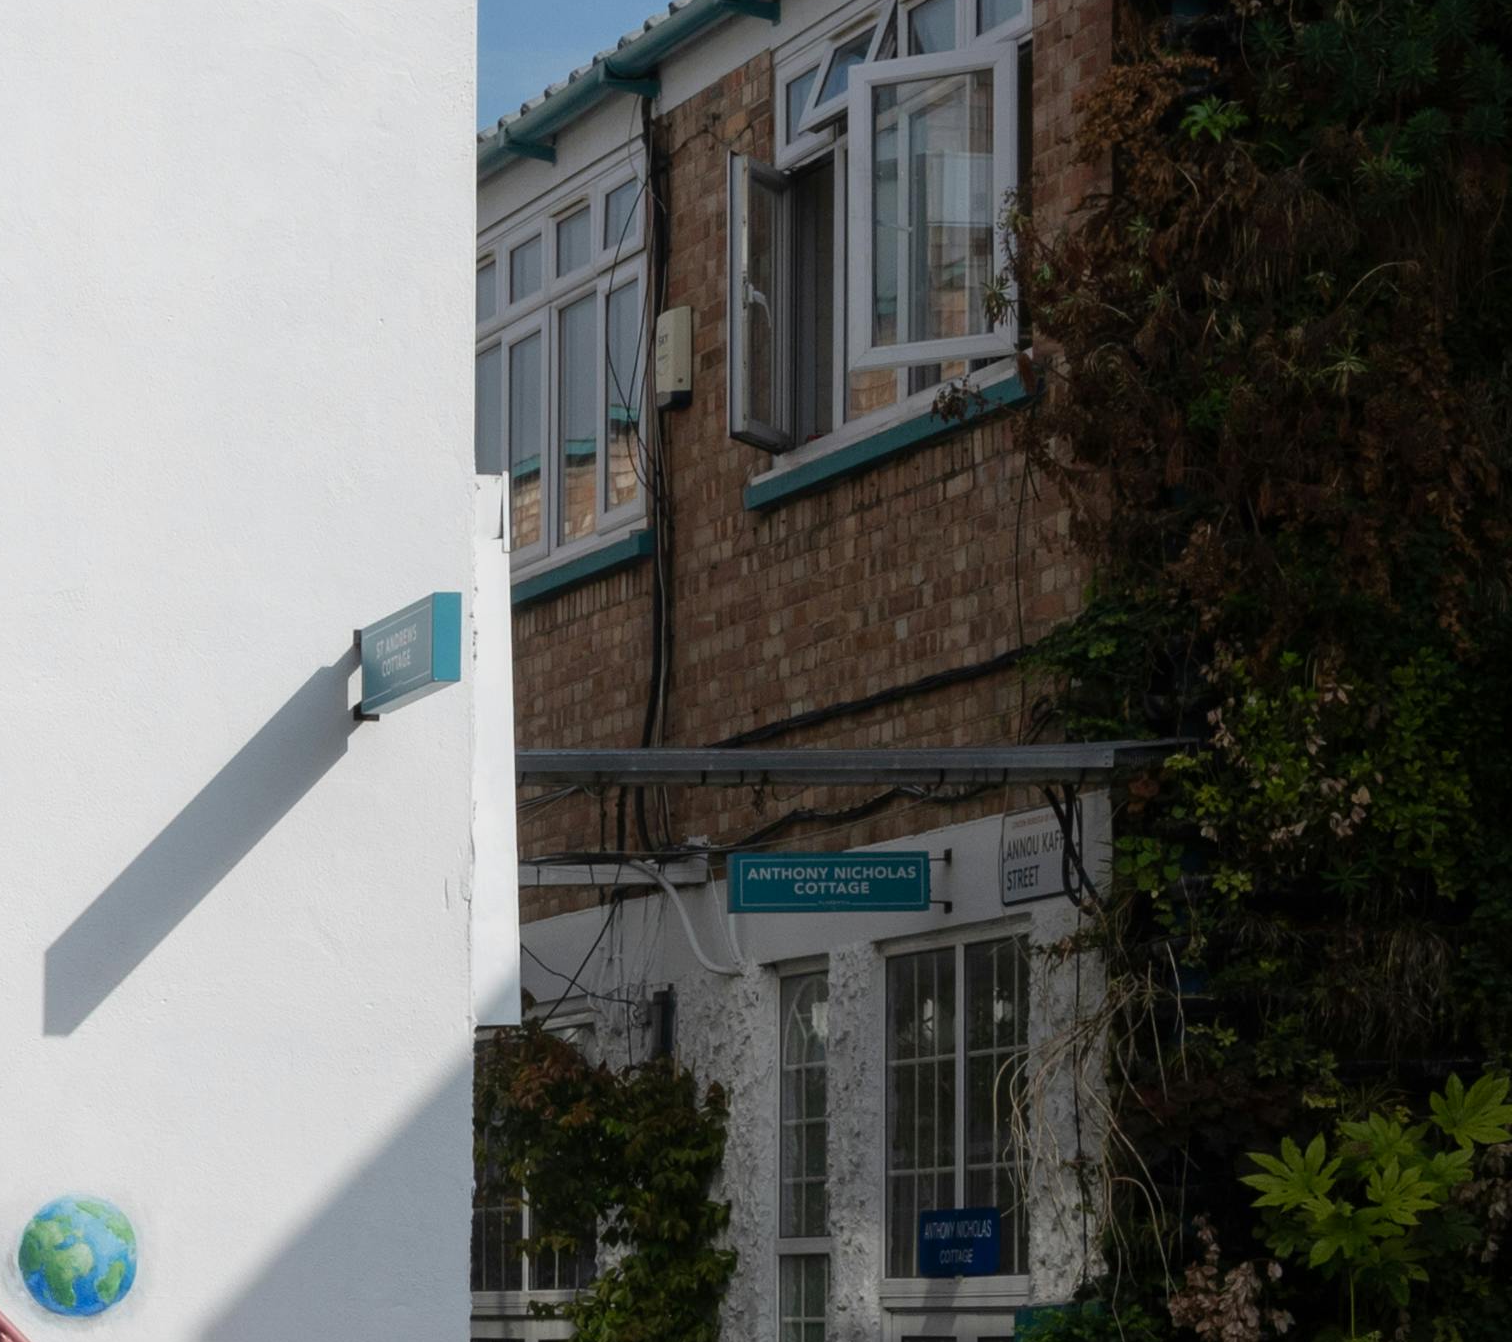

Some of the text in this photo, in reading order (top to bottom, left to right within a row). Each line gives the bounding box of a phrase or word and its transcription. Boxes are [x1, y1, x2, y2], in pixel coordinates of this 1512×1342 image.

[381, 648, 411, 677] COTTAGE
[747, 866, 917, 880] ANTHONY NICHOLAS
[1006, 864, 1040, 891] STREET
[794, 881, 871, 895] COTTAGE
[939, 1248, 974, 1265] COTTAGE
